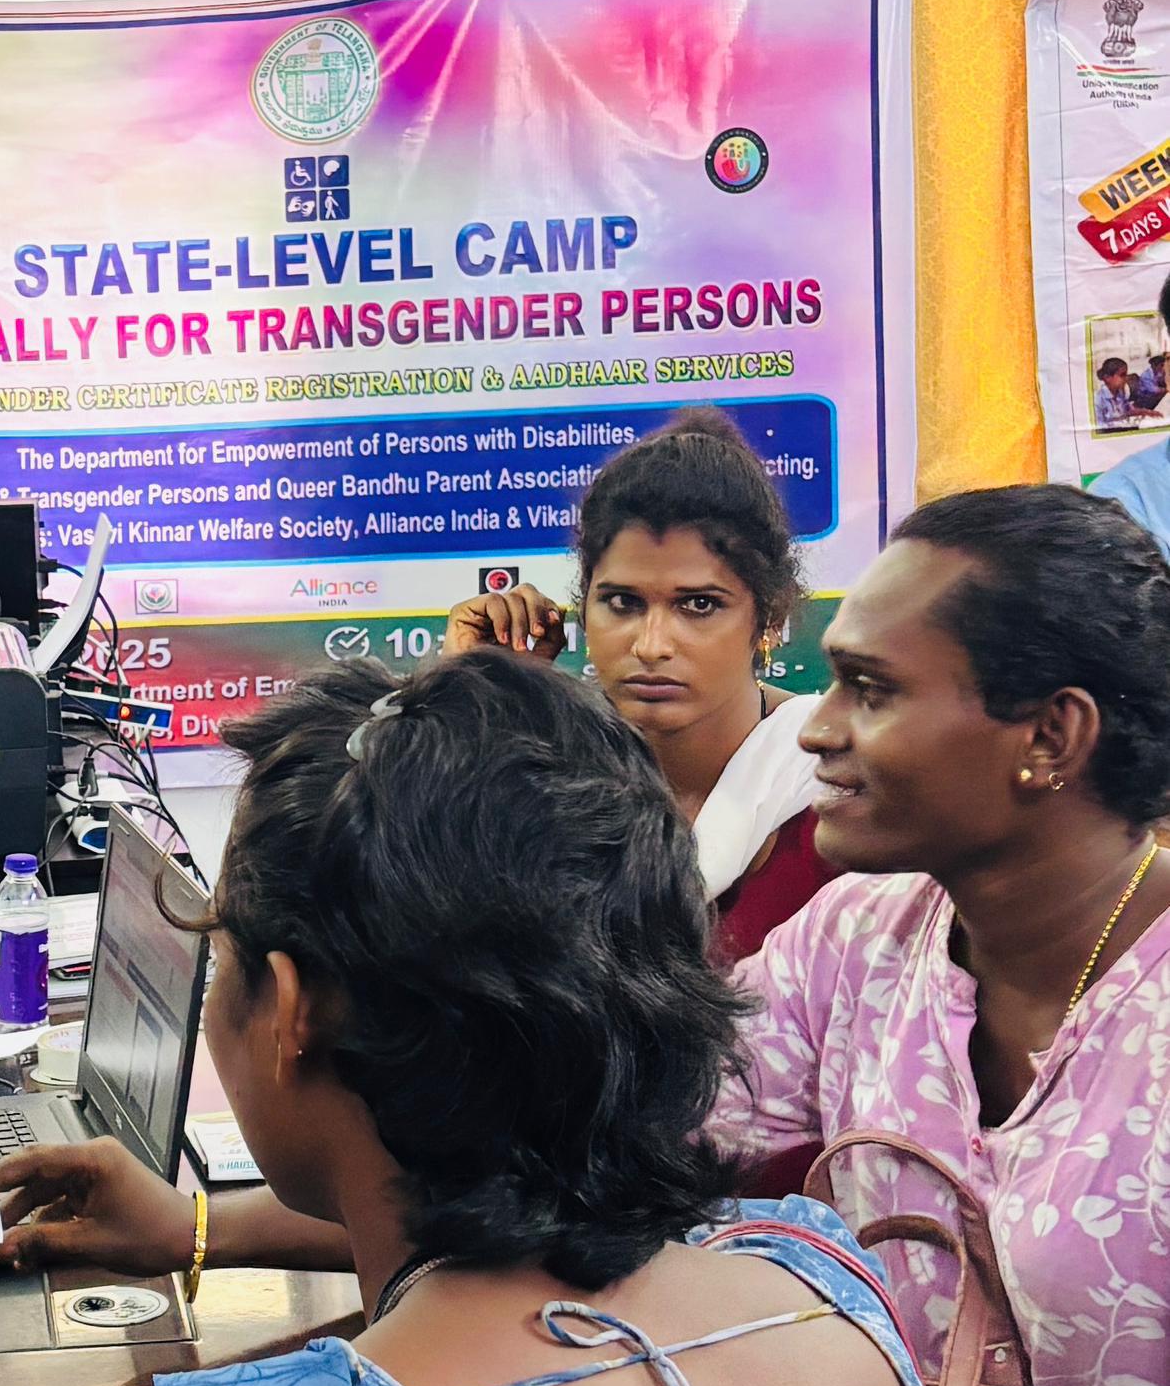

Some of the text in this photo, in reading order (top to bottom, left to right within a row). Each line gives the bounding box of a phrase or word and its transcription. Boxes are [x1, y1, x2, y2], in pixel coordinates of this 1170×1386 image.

[1099, 228, 1119, 254] 7
[1120, 211, 1162, 247] DAYS
[14, 215, 639, 299] STATE-LEVEL CAMP
[115, 313, 212, 359] FOR
[226, 291, 586, 353] TRANSGENDER
[601, 278, 823, 335] PERSONS
[76, 376, 259, 410] CERTIFICATE
[265, 367, 473, 401] REGISTRATION
[481, 365, 503, 390] &
[509, 359, 648, 390] AADHAAR
[655, 350, 795, 383] SERVICES
[17, 422, 641, 473] The Department for Empowerment of Persons with Disabilities.
[147, 480, 229, 507] Persons
[234, 479, 271, 502] and
[276, 476, 336, 501] Queer
[342, 472, 420, 497] Bandhu
[426, 469, 493, 493] Parent
[129, 521, 194, 544] Kinnar
[198, 516, 274, 542] Welfare
[279, 515, 359, 542] Society,
[364, 509, 446, 536] Alliance
[451, 508, 501, 532] India
[506, 507, 522, 529] &
[289, 578, 379, 598] Alliance
[318, 598, 348, 607] INDIA
[221, 676, 248, 698] of
